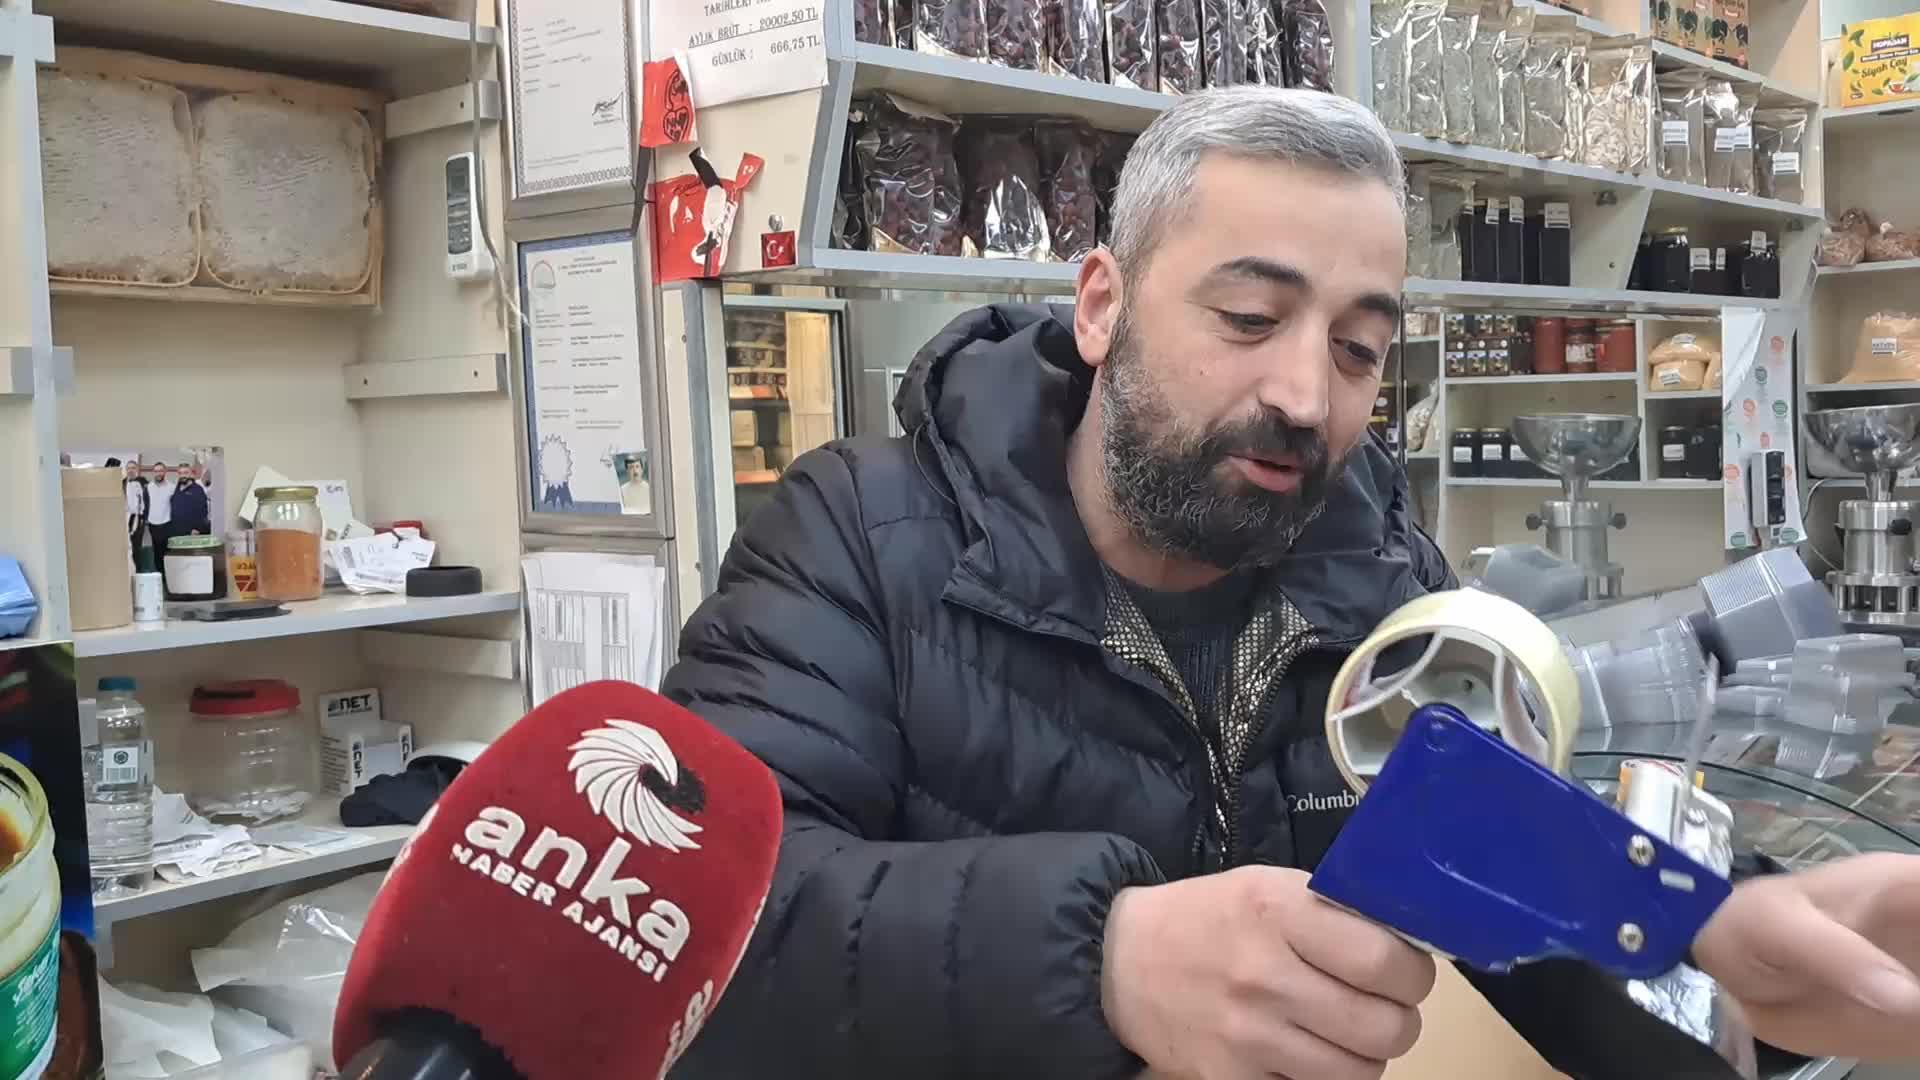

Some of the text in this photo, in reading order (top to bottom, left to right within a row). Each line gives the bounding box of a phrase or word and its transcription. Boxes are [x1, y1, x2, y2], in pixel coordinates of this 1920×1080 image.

[711, 48, 746, 66] GÜNLÜK
[770, 36, 805, 55] 666,75
[808, 34, 821, 47] TL
[806, 7, 819, 20] TL
[452, 842, 668, 983] HABER AJANSI
[464, 805, 691, 962] anka
